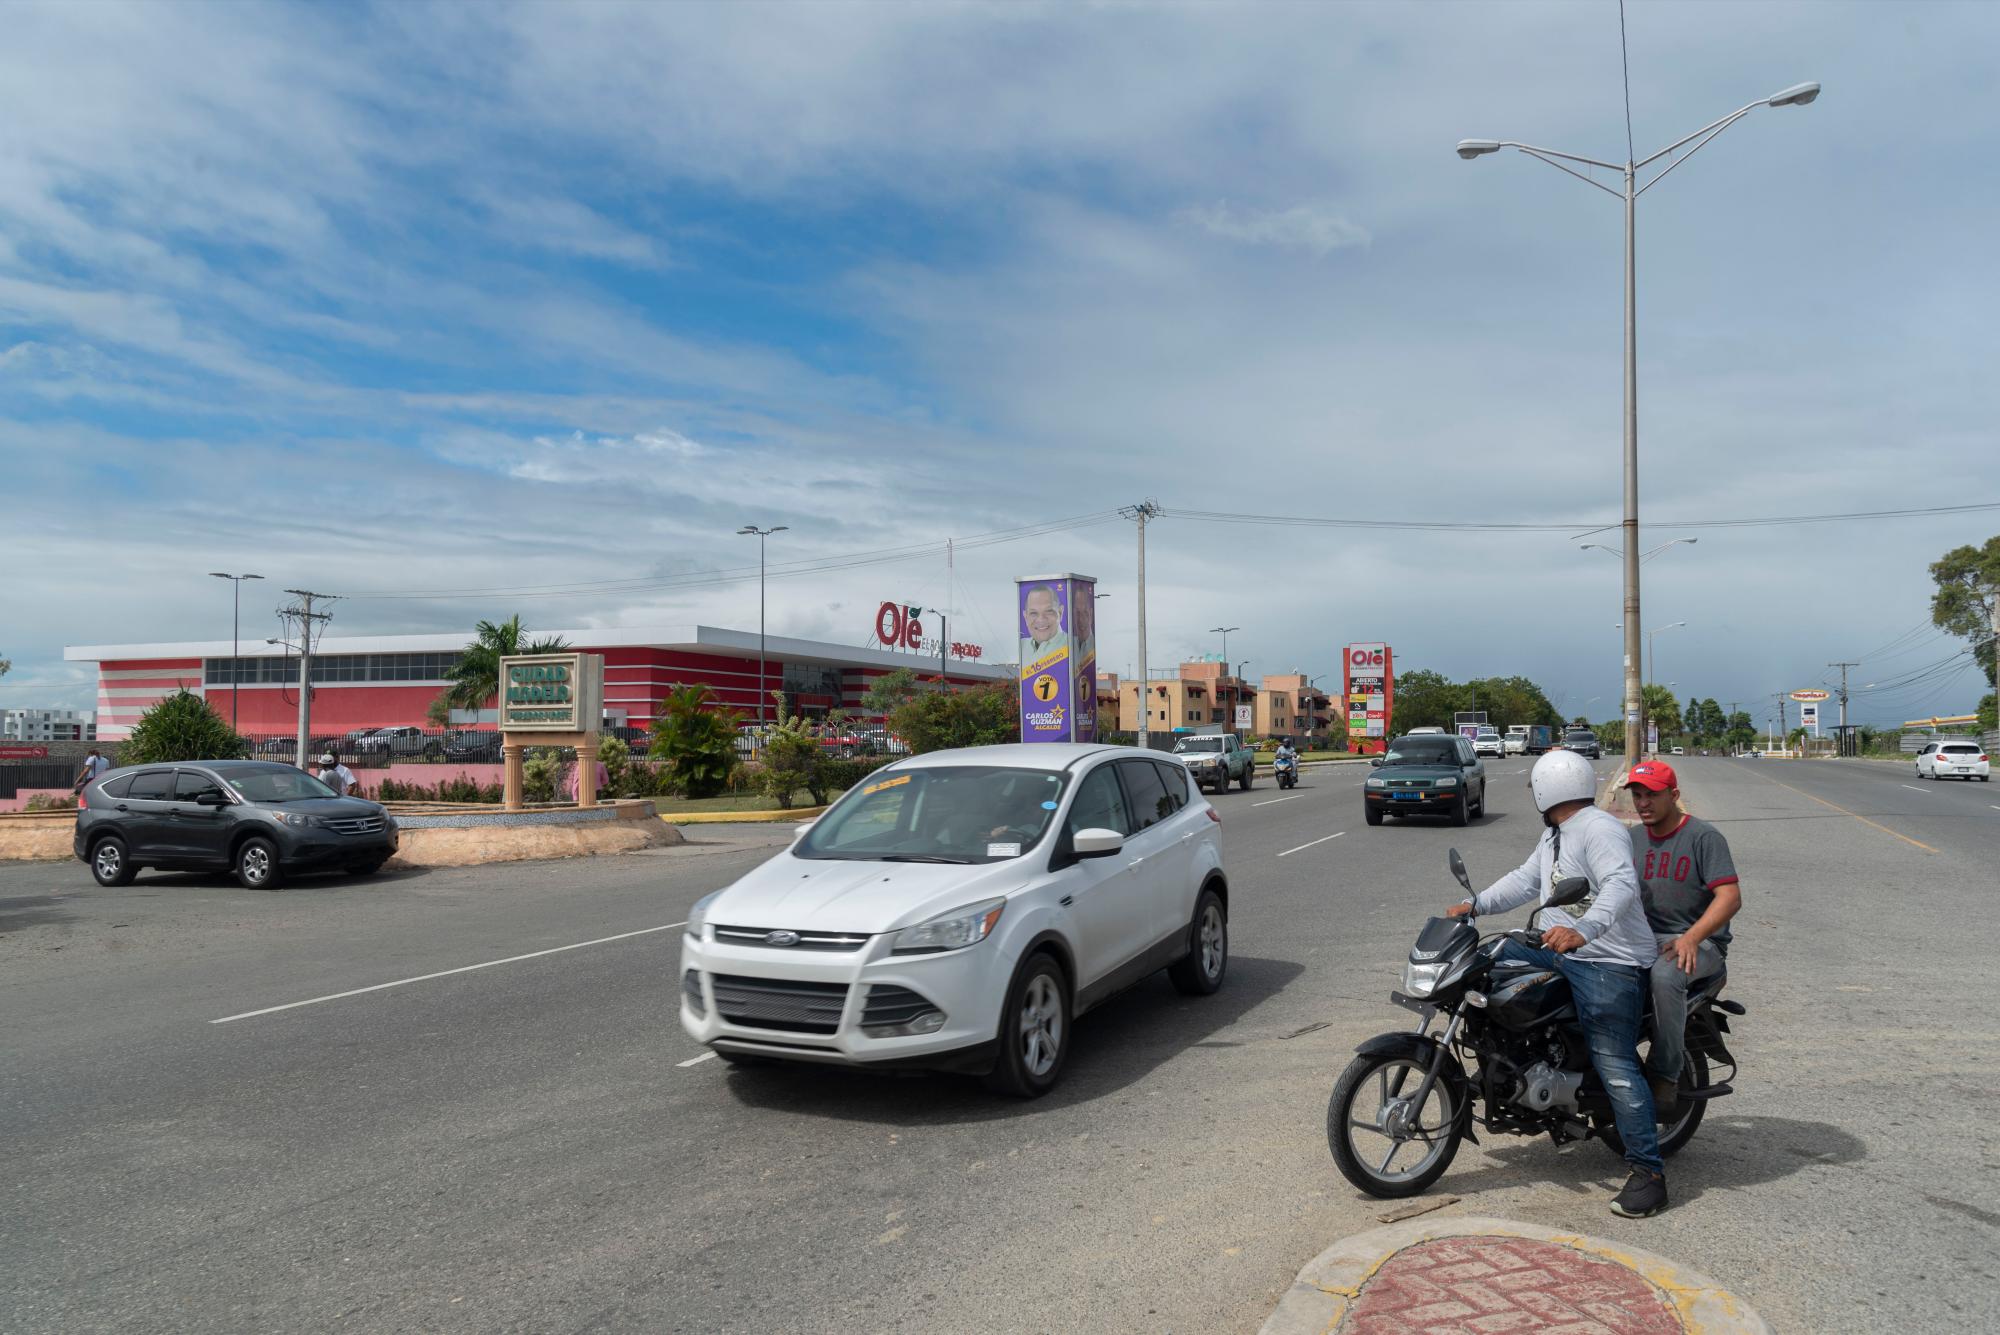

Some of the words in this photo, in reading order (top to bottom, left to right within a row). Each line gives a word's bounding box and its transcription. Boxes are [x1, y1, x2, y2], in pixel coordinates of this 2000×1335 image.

[1352, 650, 1383, 665] Olé
[511, 665, 568, 682] CIUDAD
[1031, 661, 1042, 672] 16
[507, 685, 570, 702] MODELO
[1039, 682, 1051, 700] 1
[1362, 685, 1375, 694] 12
[1025, 712, 1054, 720] CARLOS
[1633, 848, 1691, 882] ÉRO
